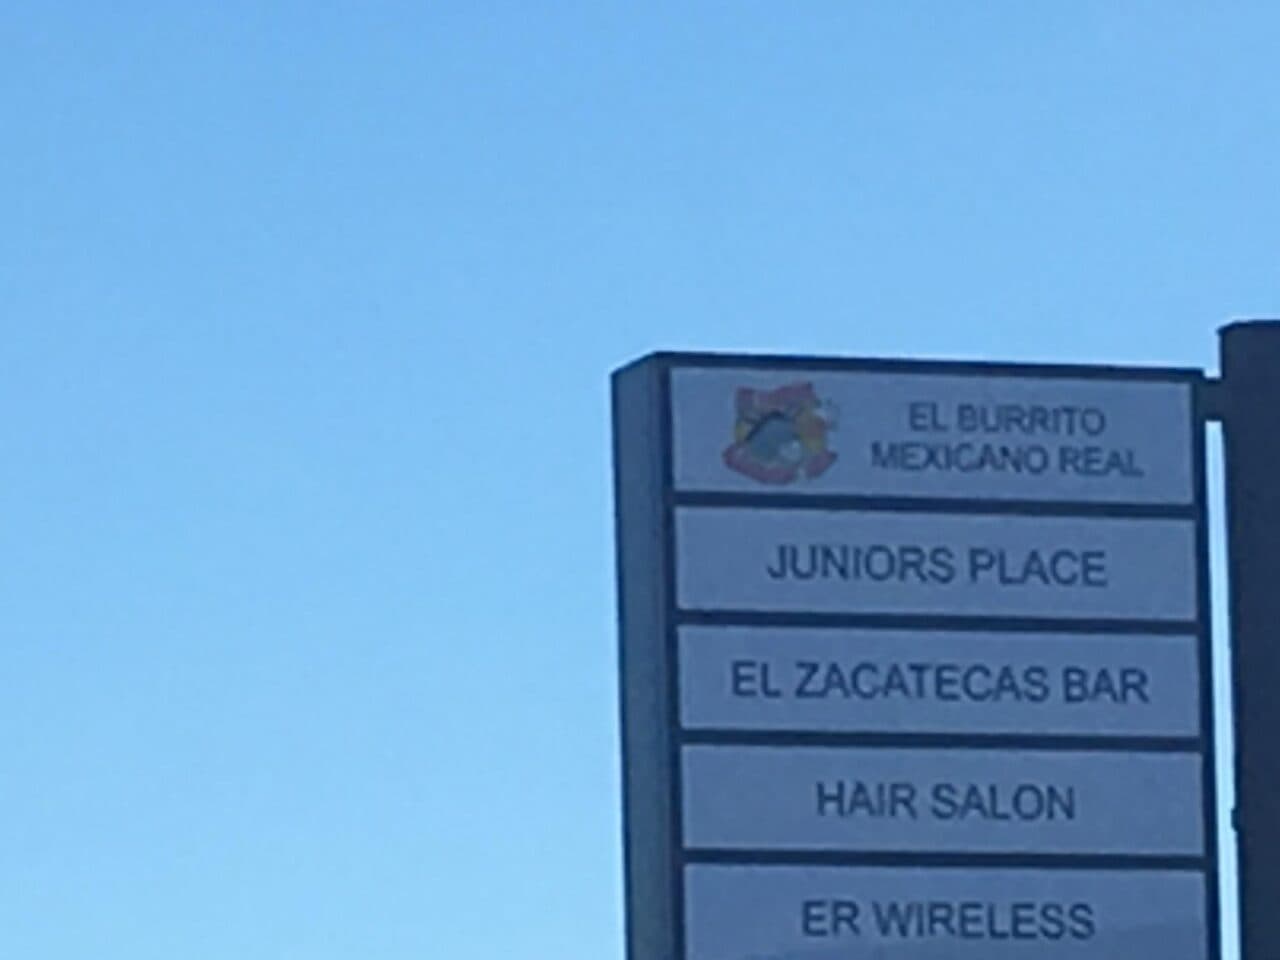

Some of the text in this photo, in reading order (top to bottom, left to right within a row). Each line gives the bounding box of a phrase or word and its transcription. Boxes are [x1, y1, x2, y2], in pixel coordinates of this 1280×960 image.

[909, 402, 1107, 436] EL BURRITO
[870, 442, 1145, 478] MEXICANO REAL
[767, 545, 1108, 587] JUNIORS PLACE
[731, 661, 1150, 703] EL ZACATECAS BAR
[816, 781, 1075, 821] HAIR SALON
[801, 900, 1096, 940] ER WIRELESS
